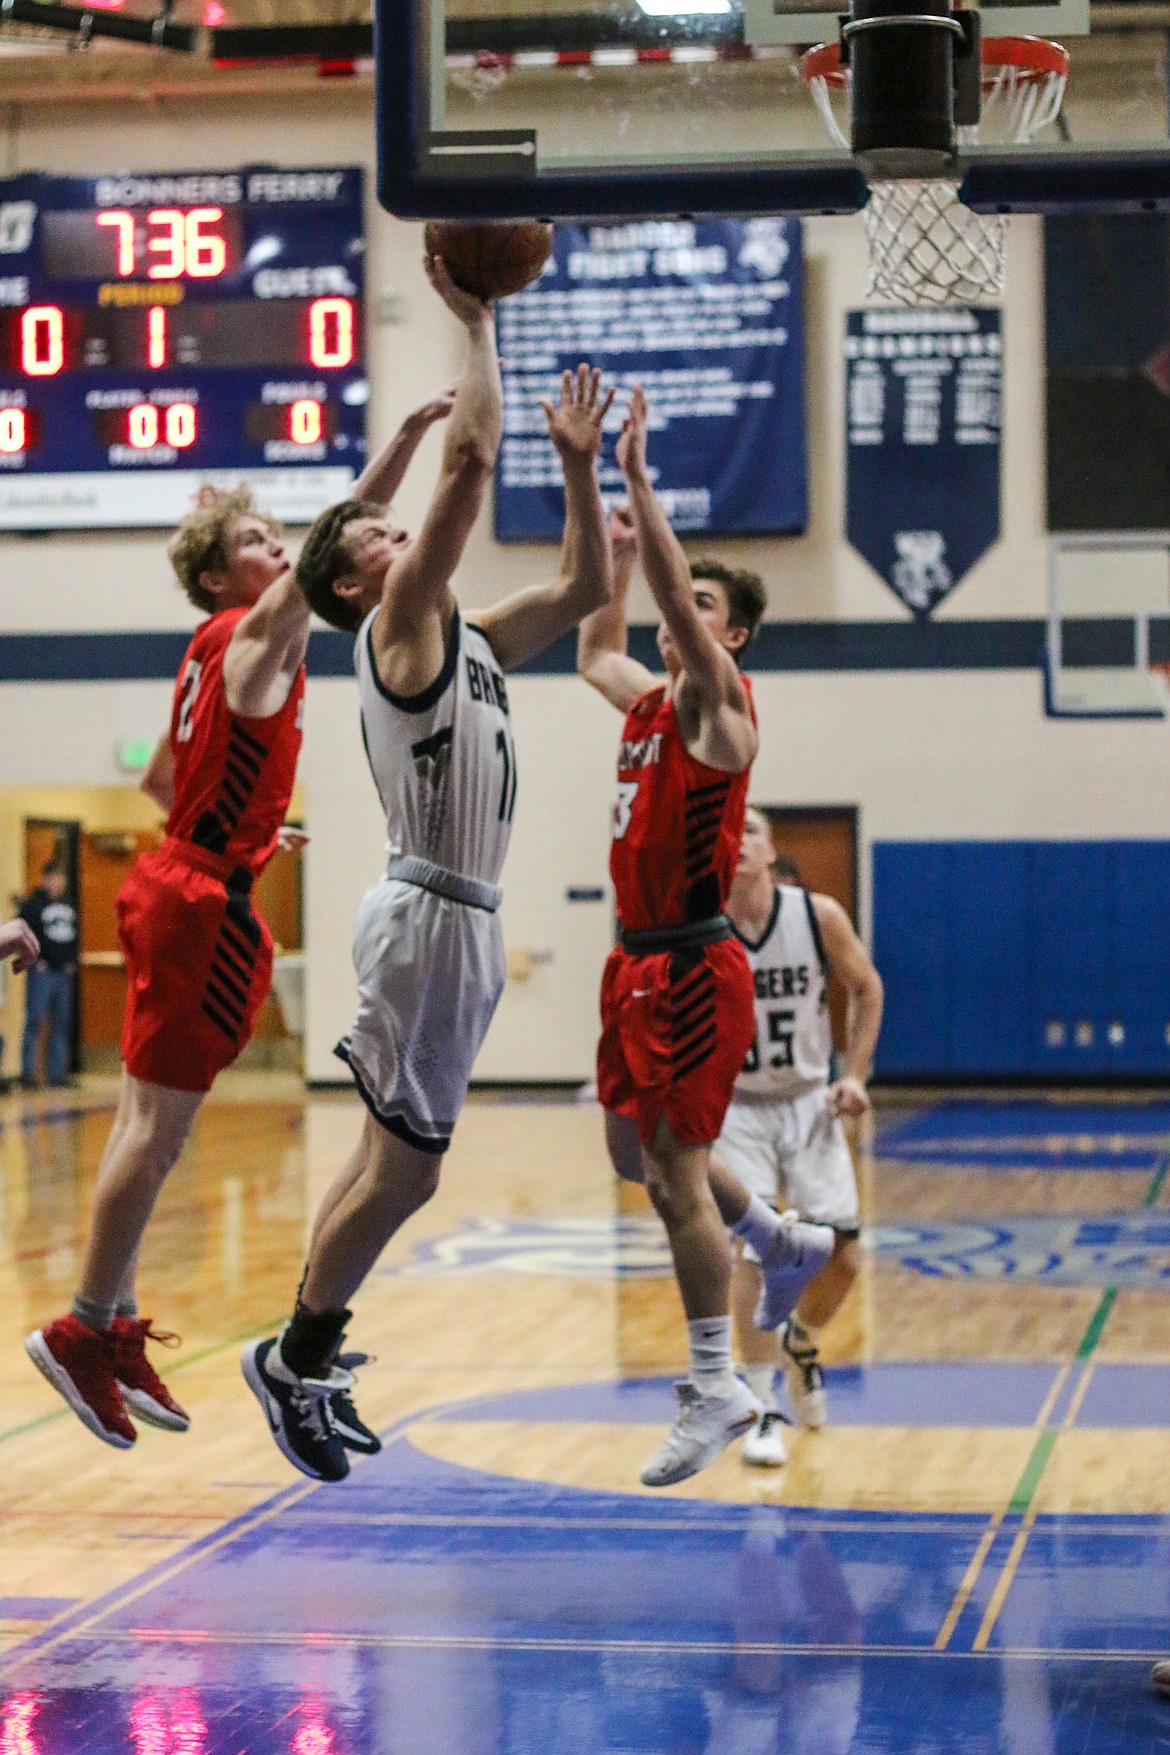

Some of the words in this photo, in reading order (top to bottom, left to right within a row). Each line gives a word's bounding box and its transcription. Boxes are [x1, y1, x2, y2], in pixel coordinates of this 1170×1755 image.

[96, 175, 242, 206] BONNERS
[249, 172, 344, 201] FERRY
[22, 306, 63, 376] 0
[149, 305, 166, 369] 1
[310, 298, 353, 368] 0
[129, 403, 196, 449] 00
[290, 399, 321, 444] 0
